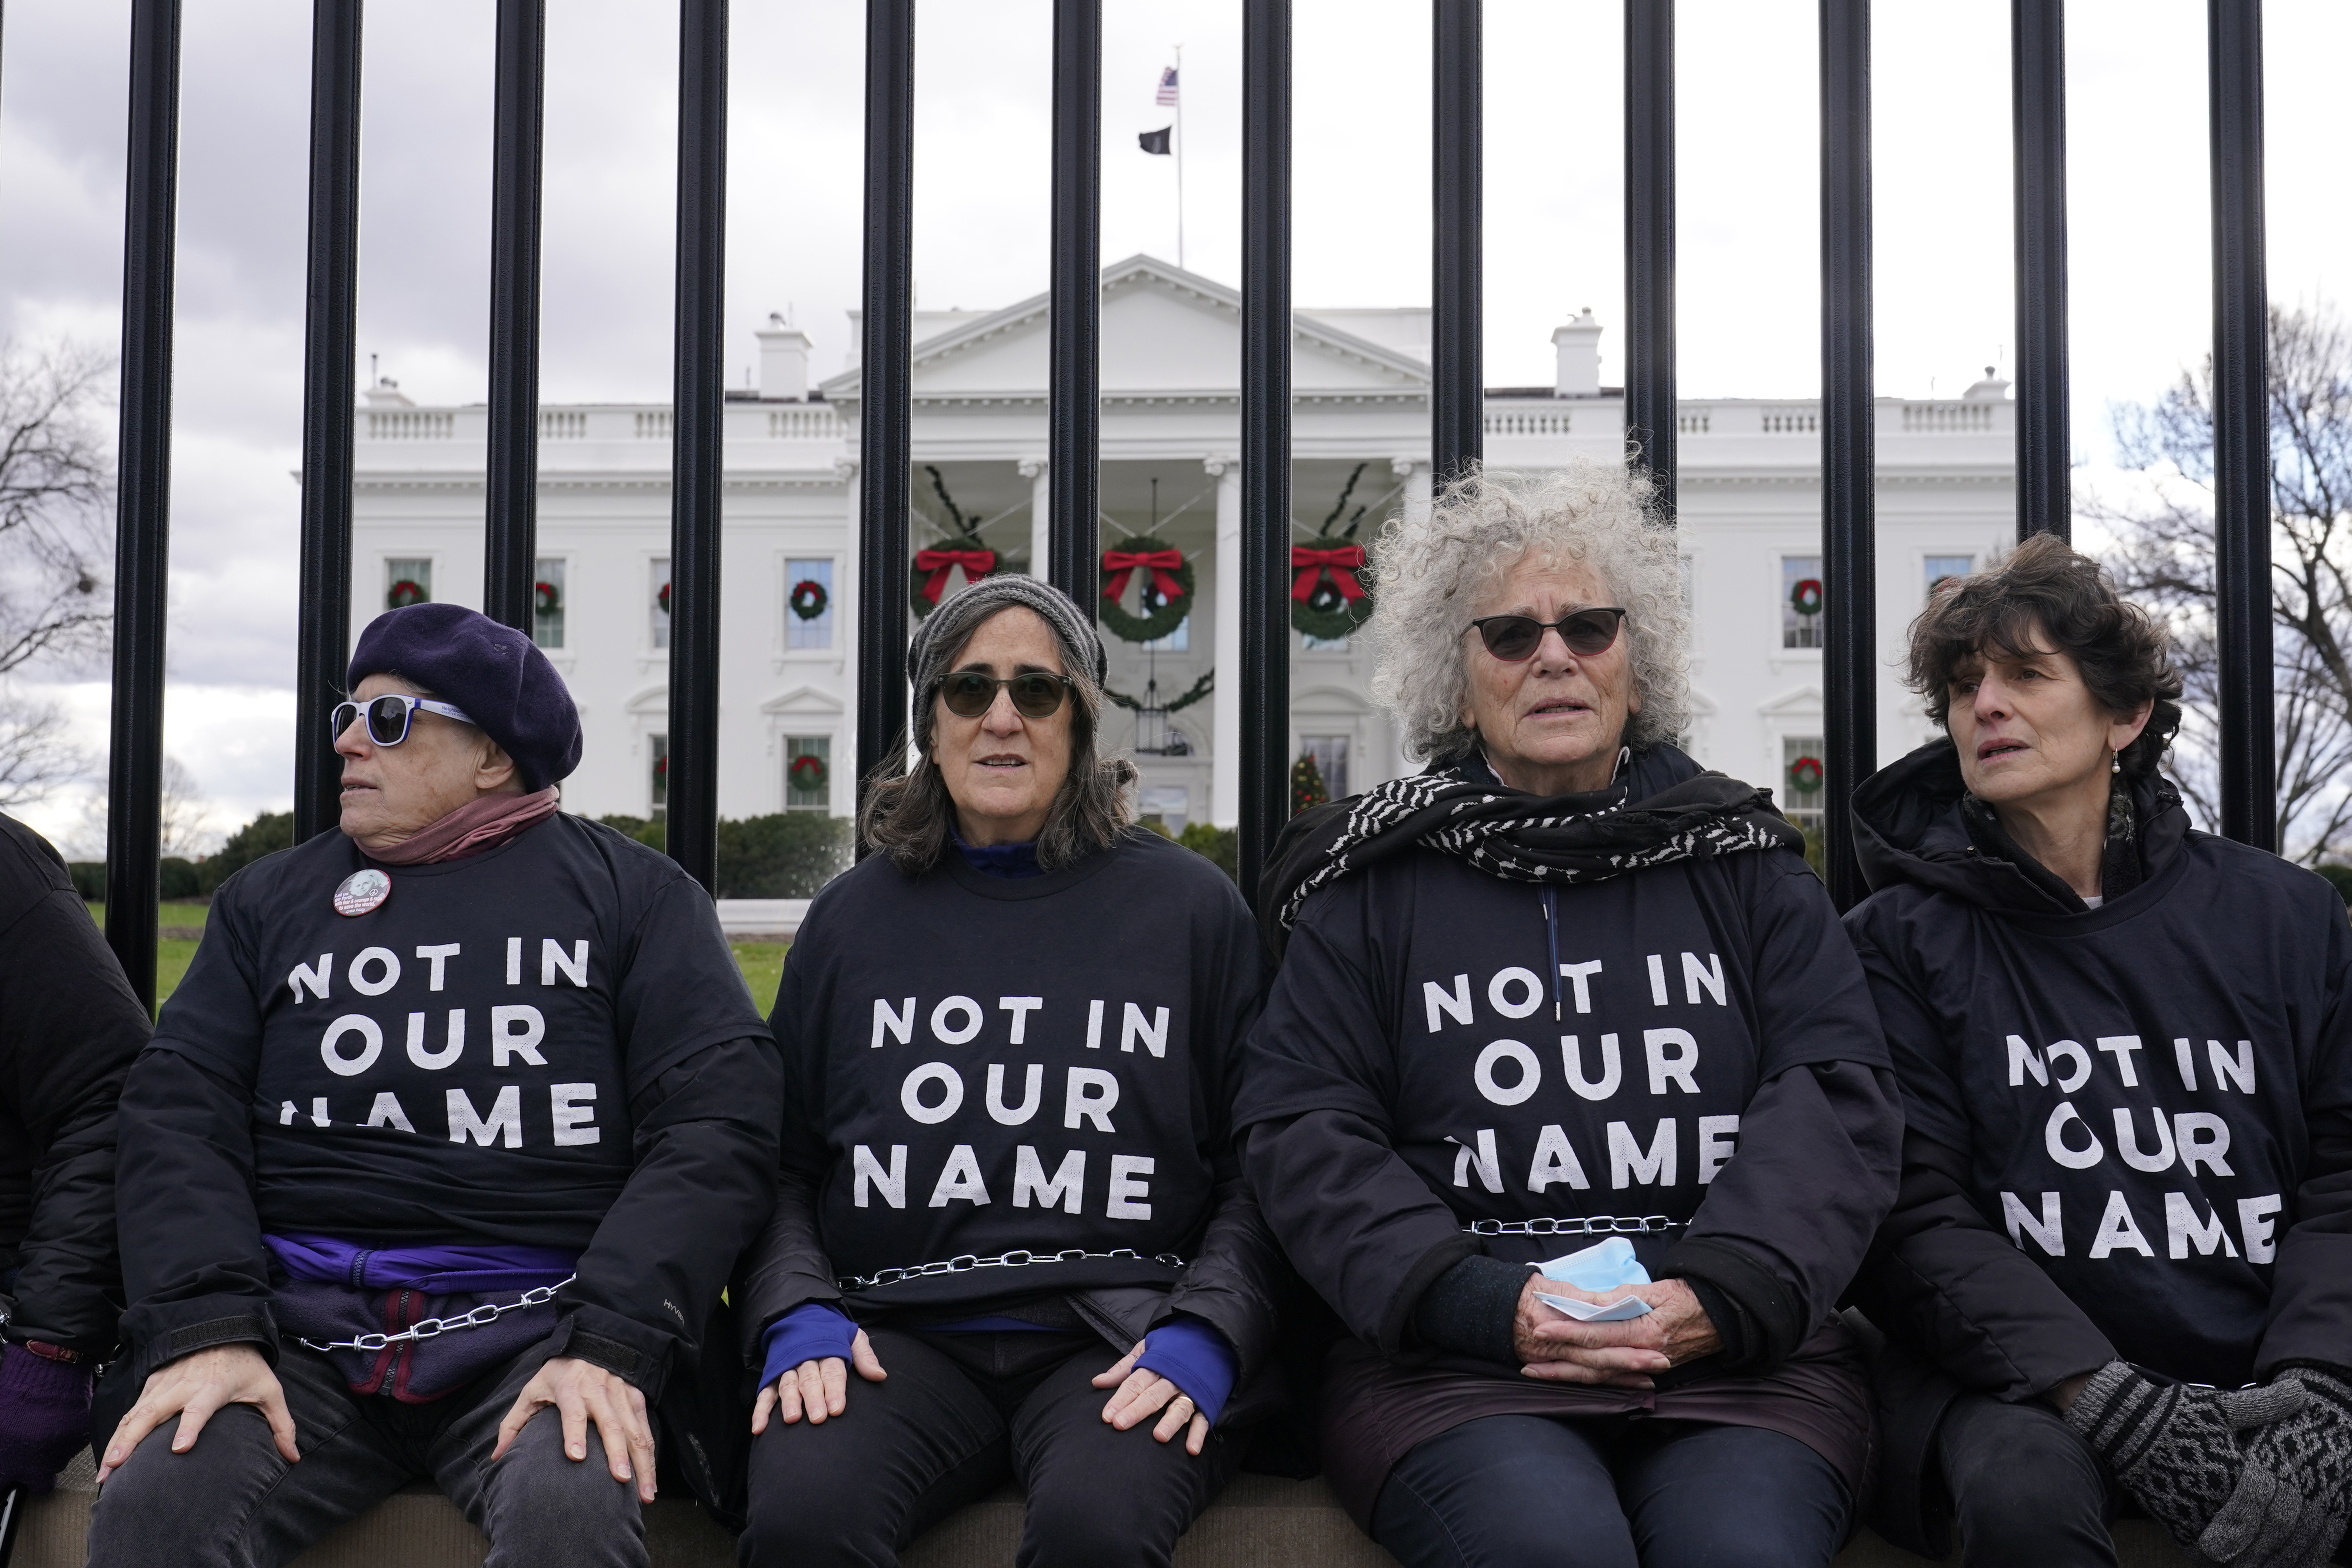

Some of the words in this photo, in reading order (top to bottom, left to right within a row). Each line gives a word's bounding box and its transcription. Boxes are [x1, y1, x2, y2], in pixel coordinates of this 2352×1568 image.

[288, 943, 460, 1004] NOT
[506, 937, 589, 988] IN
[1423, 960, 1602, 1033] NOT
[1647, 952, 1727, 1006] IN
[321, 1005, 548, 1076] OUR
[871, 995, 1043, 1048] NOT
[1086, 1000, 1170, 1058] IN
[901, 1062, 1119, 1133] OUR
[1474, 1028, 1701, 1106] OUR
[2006, 1035, 2142, 1093] NOT
[2174, 1038, 2255, 1094] IN
[1443, 1114, 1739, 1194] NAME
[2045, 1101, 2235, 1177] OUR
[853, 1144, 1155, 1220] NAME
[2000, 1190, 2282, 1264] NAME
